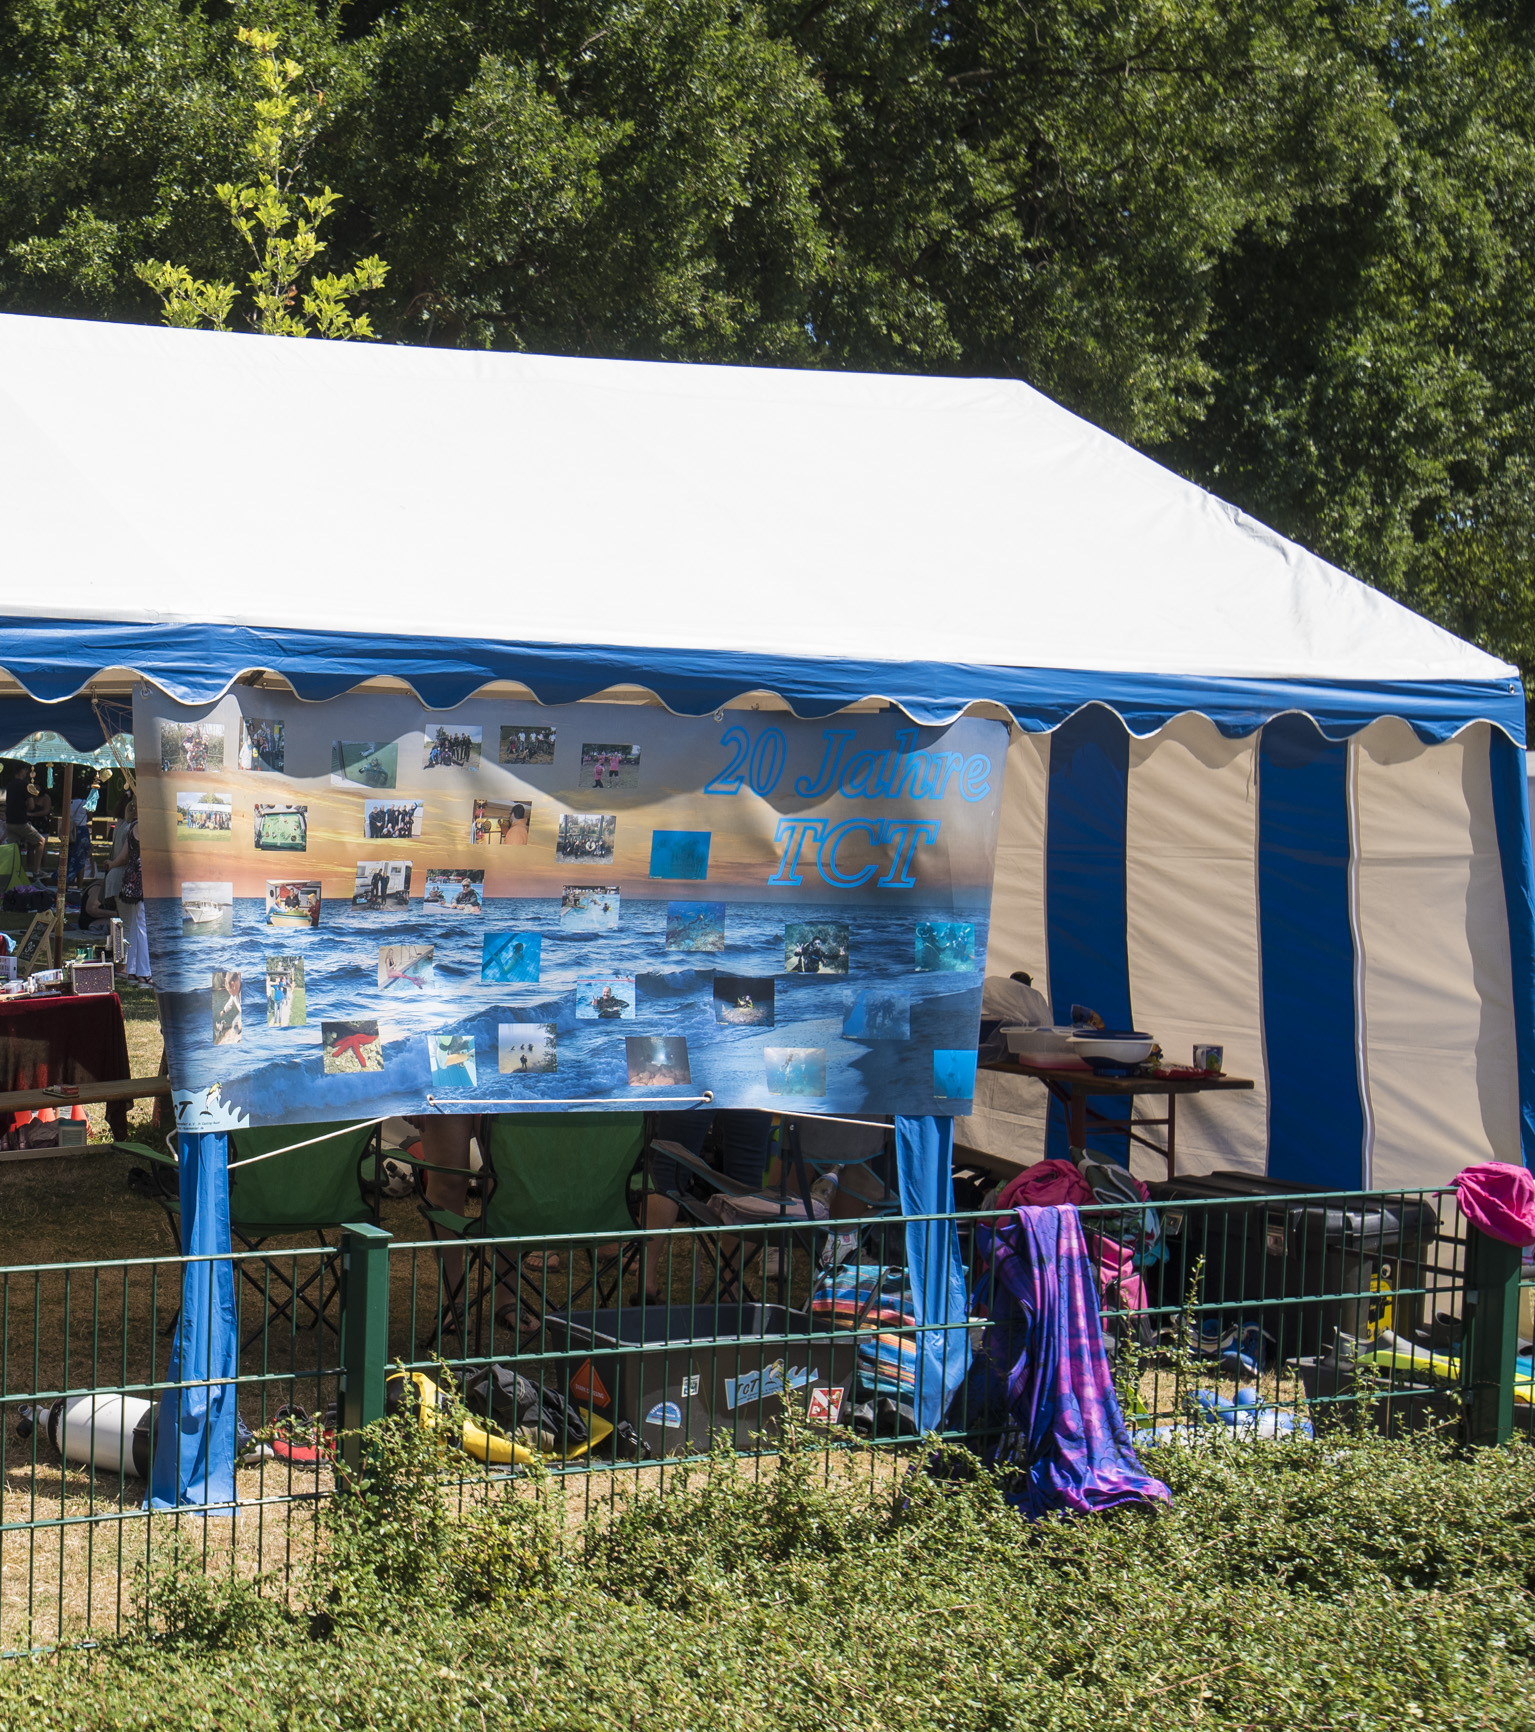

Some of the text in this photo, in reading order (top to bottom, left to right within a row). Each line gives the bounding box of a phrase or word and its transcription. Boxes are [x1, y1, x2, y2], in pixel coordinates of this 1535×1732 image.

[704, 725, 991, 802] 20 Jahre
[767, 817, 942, 888] TCT
